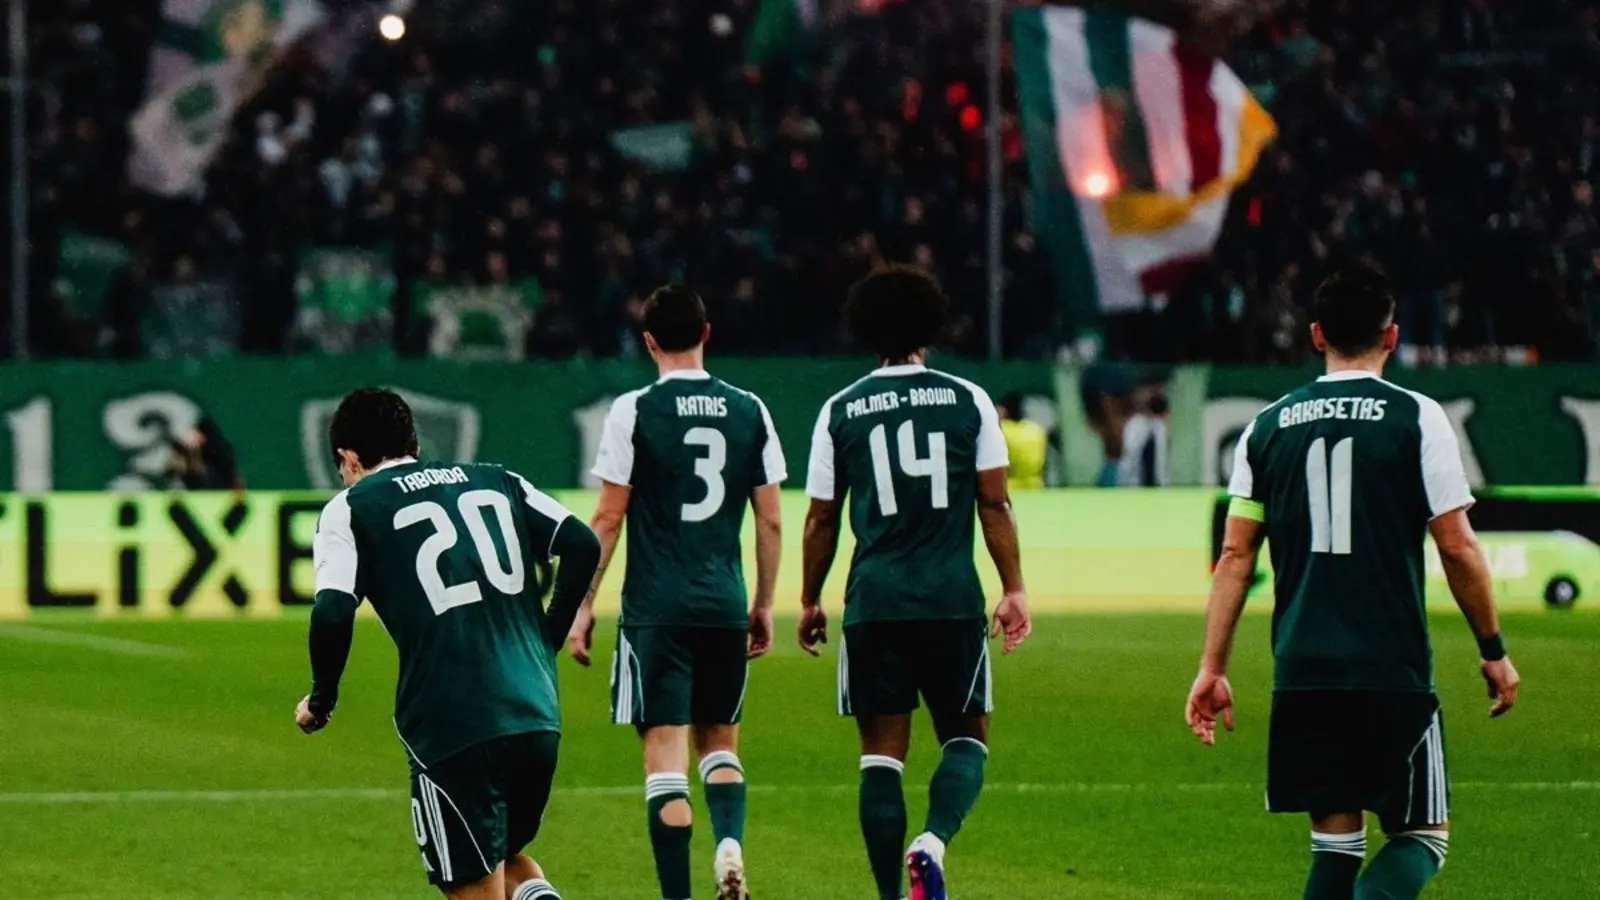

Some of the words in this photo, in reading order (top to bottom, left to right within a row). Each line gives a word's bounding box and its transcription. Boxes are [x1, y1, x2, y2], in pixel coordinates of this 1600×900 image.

[676, 395, 728, 417] KATRIS
[846, 387, 957, 419] PALMER-BROWN
[1279, 397, 1388, 428] BAKASETAS
[392, 466, 470, 493] TABORDA
[681, 426, 727, 522] 3
[869, 419, 949, 516] 14
[1305, 436, 1353, 554] 11
[393, 489, 525, 616] 20
